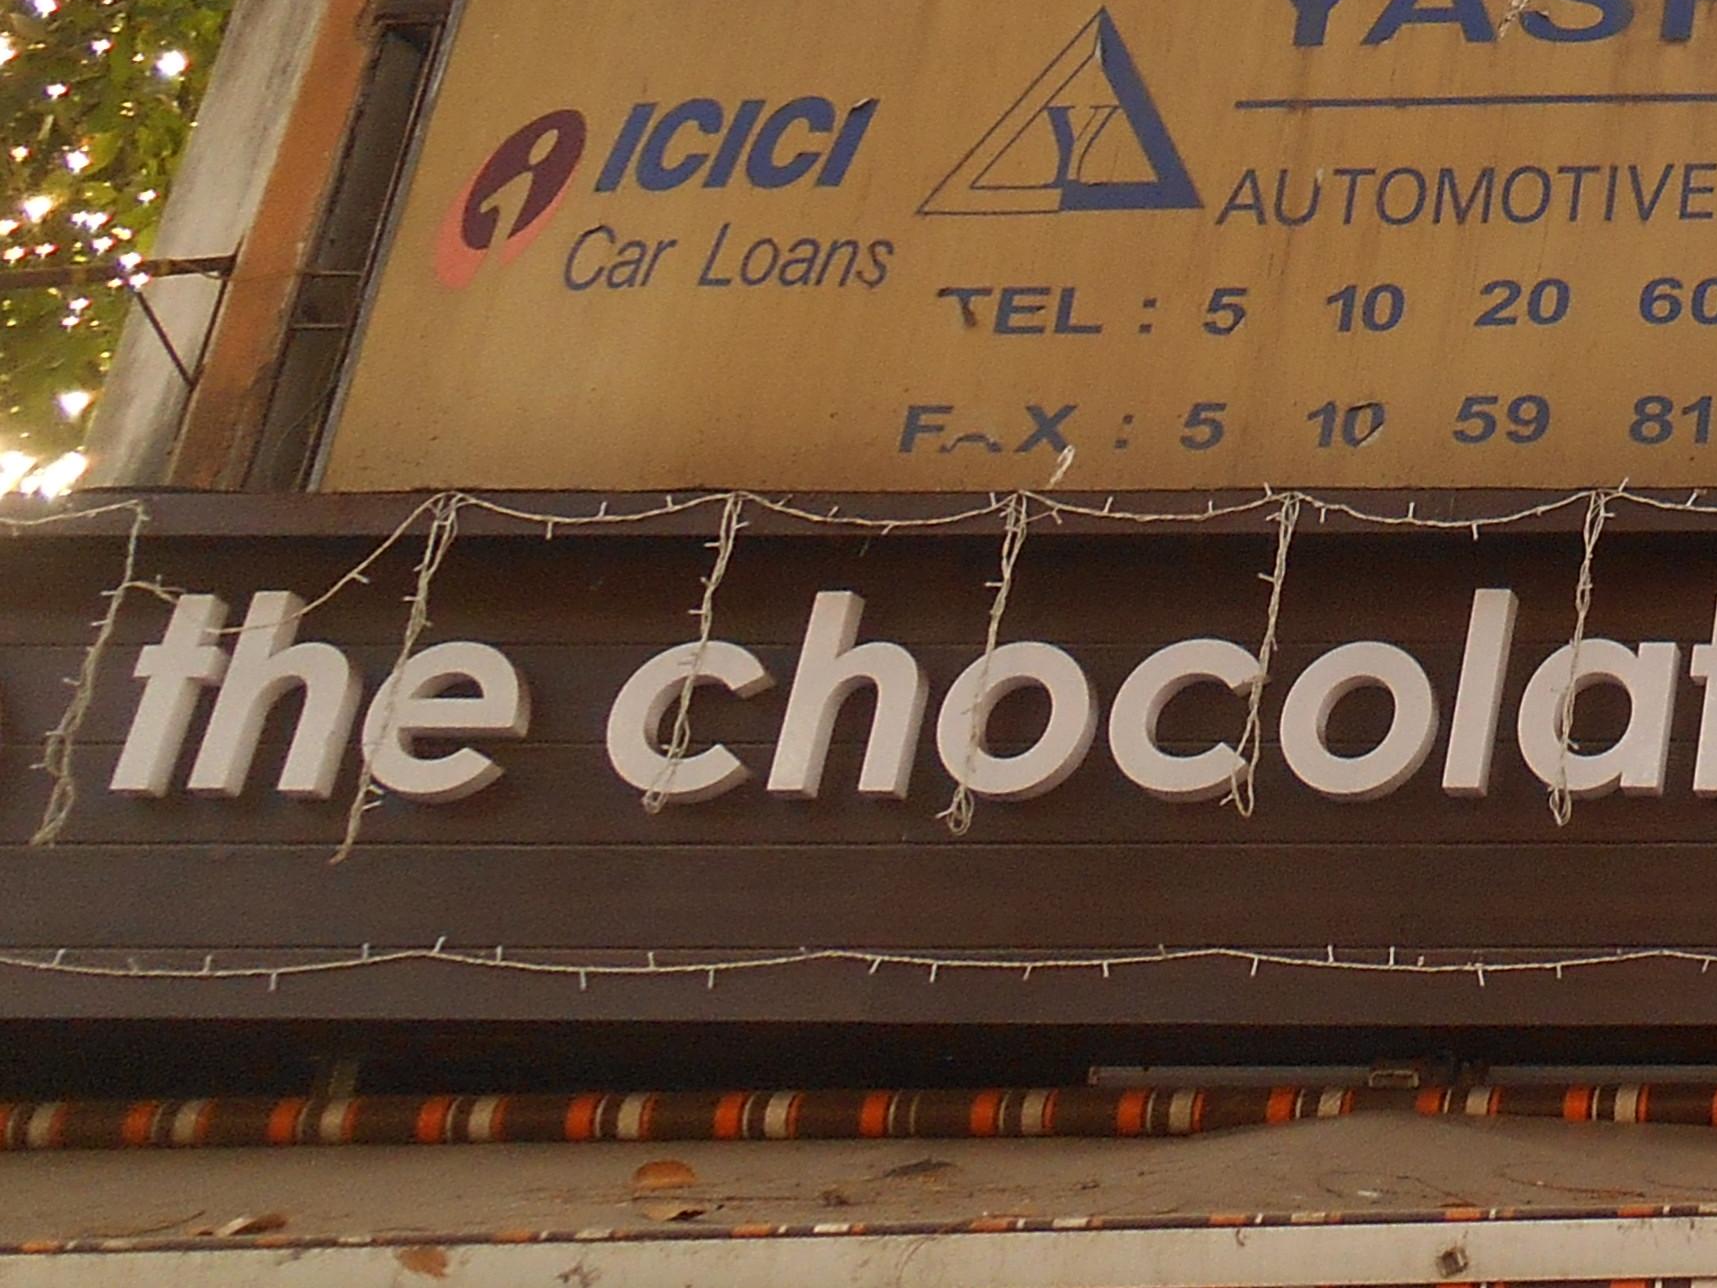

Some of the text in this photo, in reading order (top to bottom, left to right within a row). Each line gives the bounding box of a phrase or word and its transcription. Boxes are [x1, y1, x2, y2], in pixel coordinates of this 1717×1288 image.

[594, 96, 880, 193] ICICI
[564, 223, 894, 290] Car Loans
[1201, 286, 1247, 336] 5
[1325, 283, 1405, 333] 10
[1472, 277, 1571, 327] 20
[1179, 401, 1228, 451] 5
[1306, 401, 1386, 449] 10
[1453, 394, 1552, 447] 59
[1629, 394, 1716, 445] 81
[109, 589, 531, 801] the
